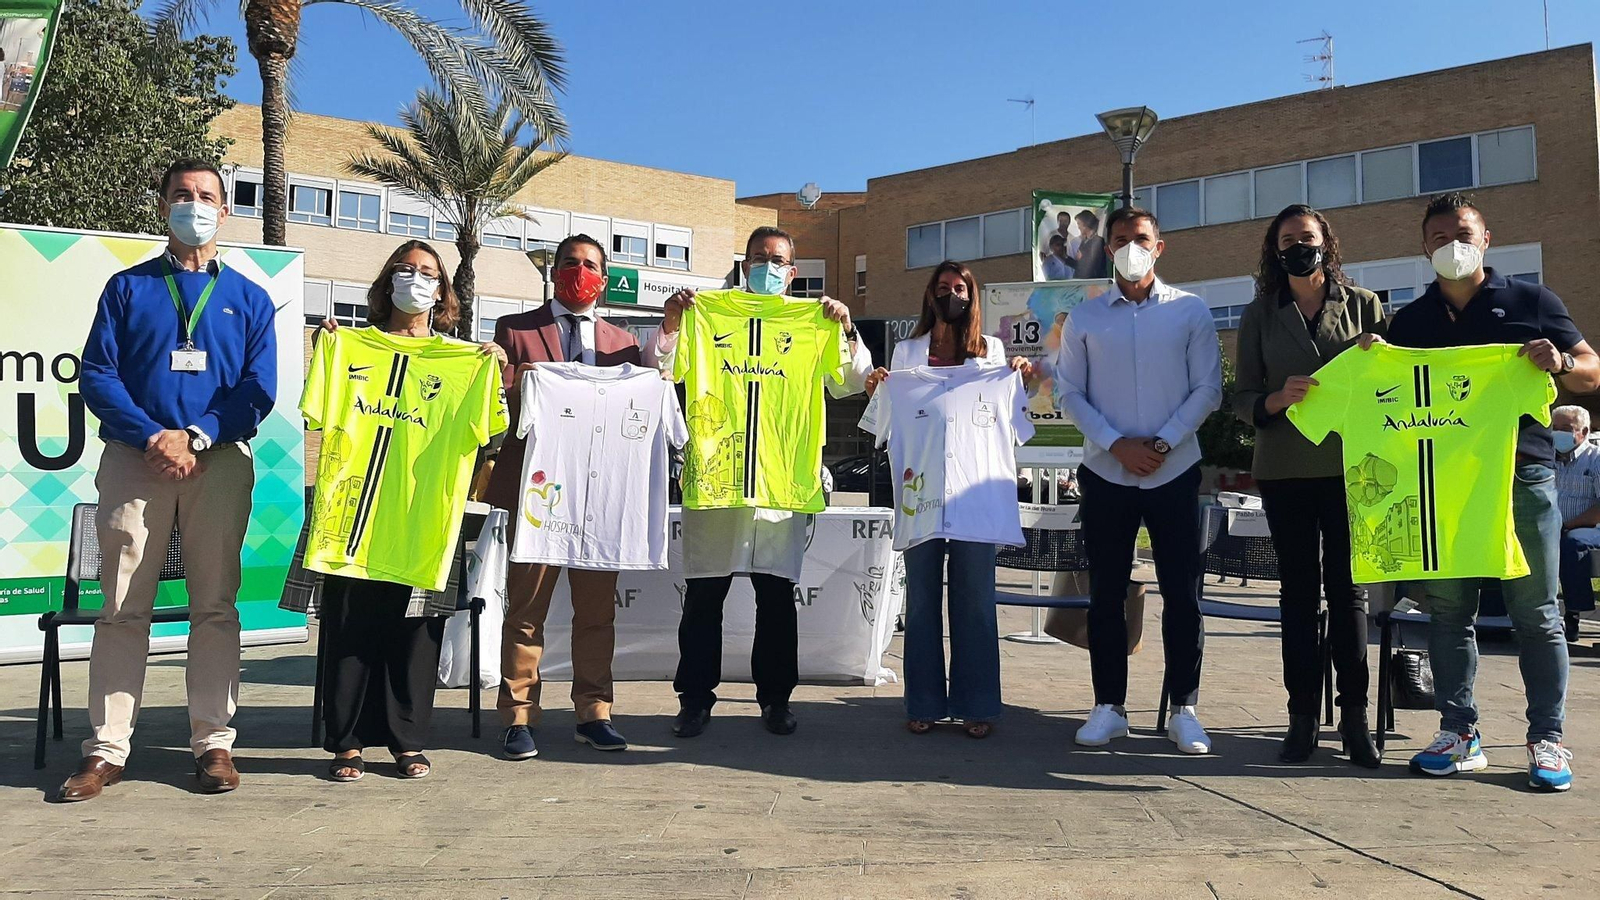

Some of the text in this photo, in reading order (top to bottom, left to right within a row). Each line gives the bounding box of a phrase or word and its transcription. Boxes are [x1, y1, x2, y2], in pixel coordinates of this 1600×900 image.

[1012, 321, 1041, 345] 13
[1006, 345, 1043, 353] noviembre
[720, 358, 789, 380] Andalucía
[353, 396, 428, 429] Andalucía
[1382, 410, 1470, 432] Andalucía
[17, 392, 86, 471] U
[544, 520, 583, 537] HOSPITAL
[24, 587, 45, 595] Salud
